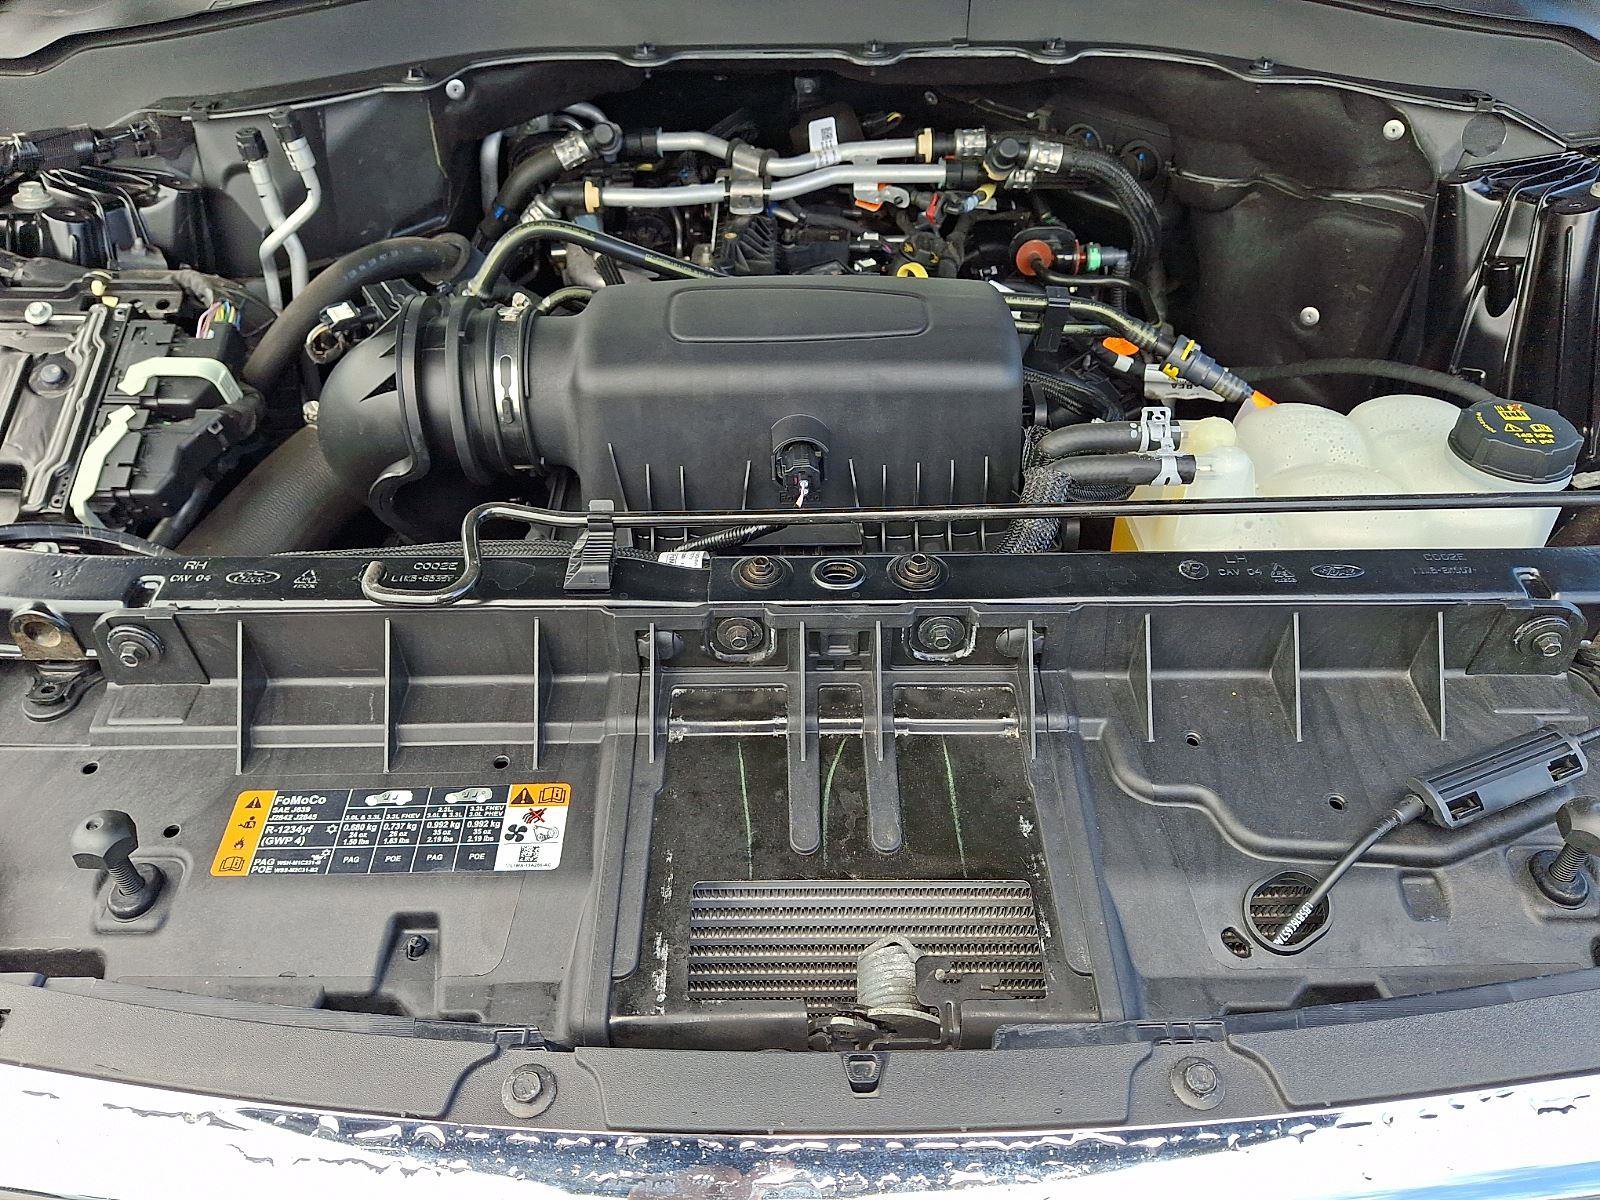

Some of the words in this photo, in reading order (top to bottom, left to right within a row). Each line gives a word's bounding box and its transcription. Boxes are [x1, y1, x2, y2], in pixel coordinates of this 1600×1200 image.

[1224, 554, 1248, 563] LH
[183, 560, 208, 570] RH
[169, 574, 193, 582] CAV
[196, 574, 212, 582] 04
[274, 795, 326, 806] FoMoCo
[366, 823, 377, 832] kg
[383, 823, 405, 831] 0.737
[405, 822, 417, 832] kg
[450, 820, 461, 829] kg
[466, 820, 489, 828] 0.992
[489, 819, 501, 829] kg
[265, 824, 314, 835] R-1234yf
[261, 836, 294, 846] (GWP
[294, 836, 306, 846] 4)
[384, 855, 402, 863] POE
[426, 853, 443, 861] PAG
[253, 858, 275, 866] PAG
[251, 866, 274, 874] POE
